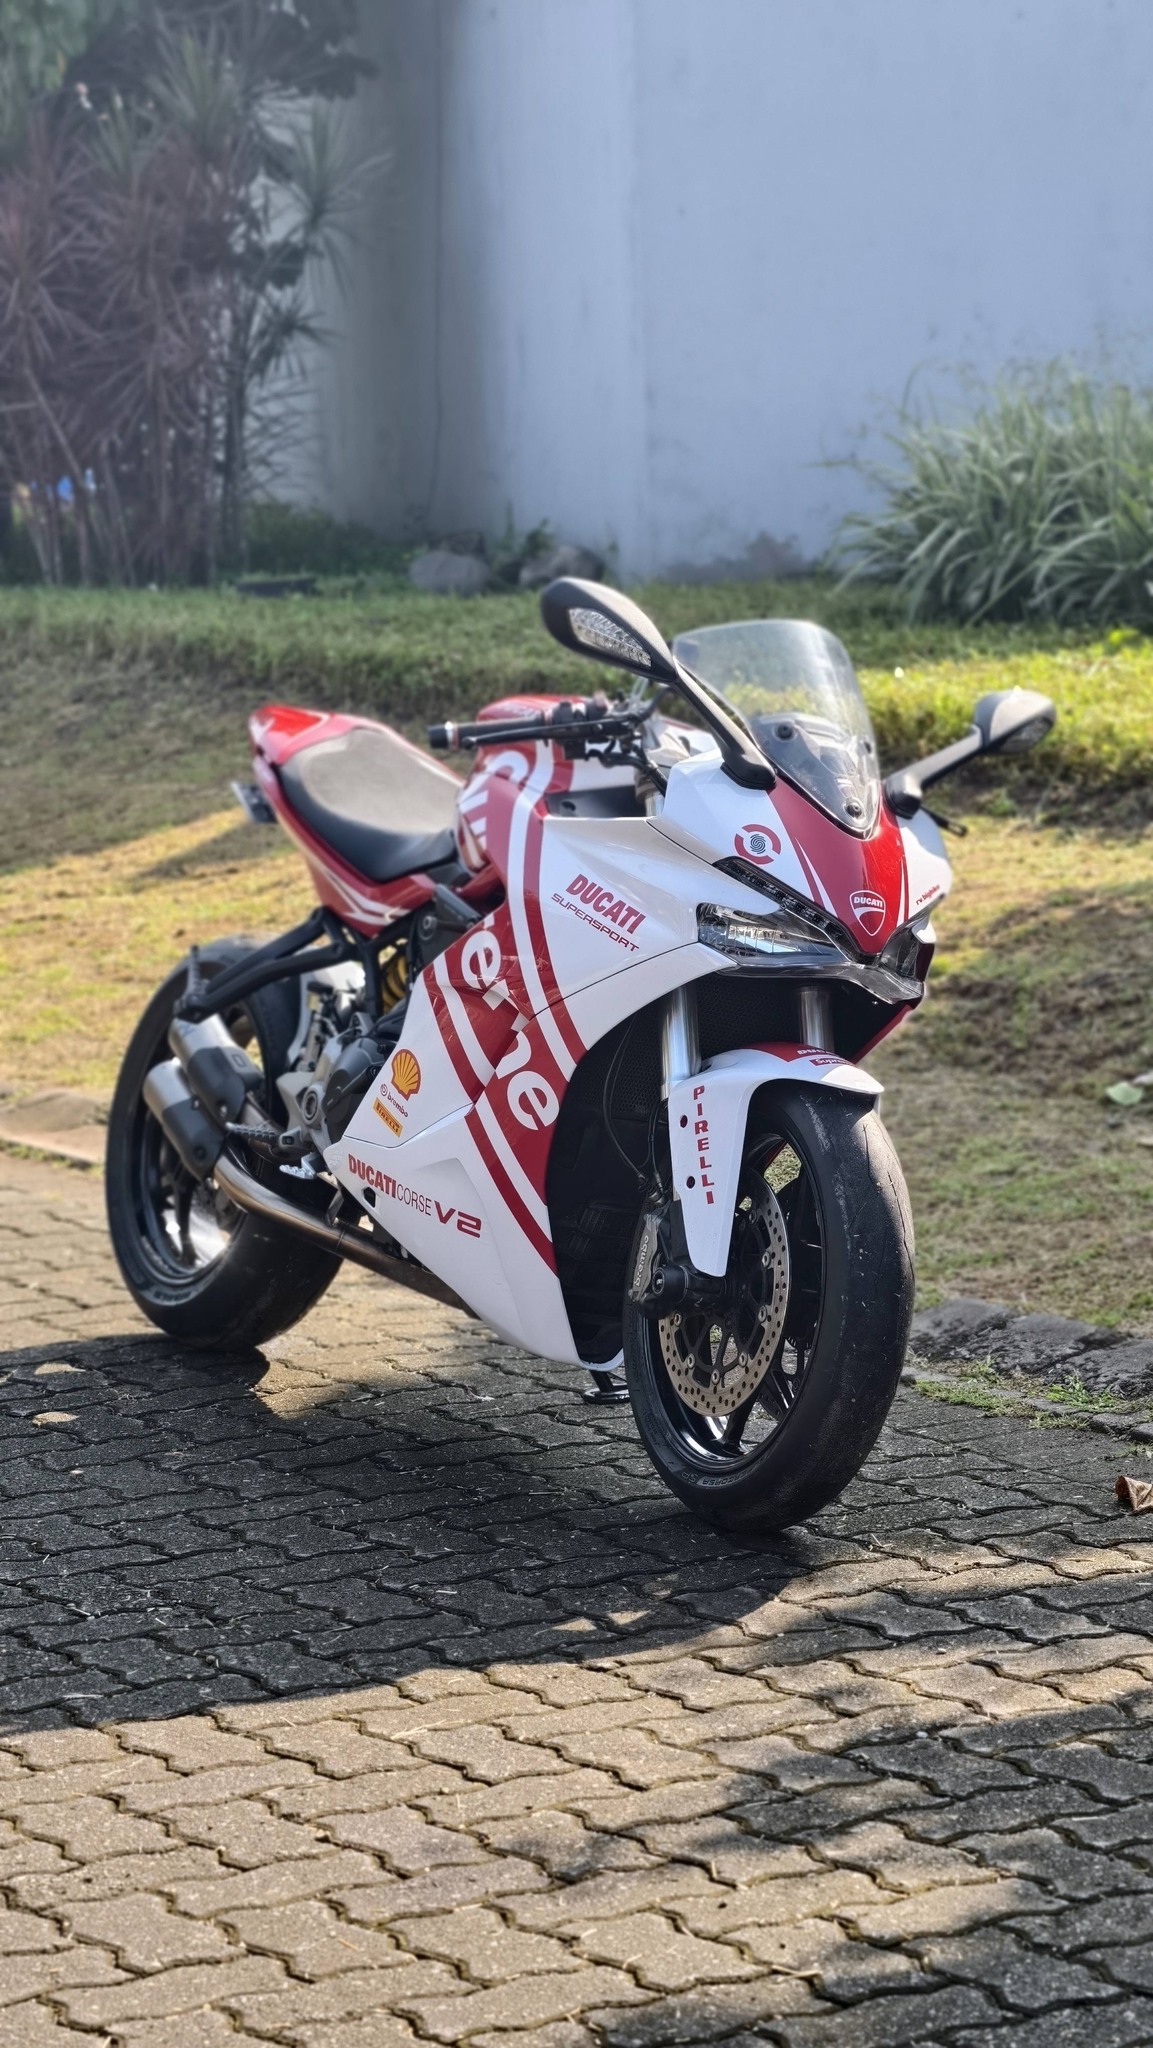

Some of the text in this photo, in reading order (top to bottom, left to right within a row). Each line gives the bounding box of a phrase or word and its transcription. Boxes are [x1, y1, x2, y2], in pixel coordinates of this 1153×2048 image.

[550, 892, 640, 952] SUPERSPORT
[565, 873, 647, 934] DUCATI
[853, 896, 884, 908] DUCATI
[376, 1102, 400, 1133] PIRELLI
[386, 1090, 409, 1118] brembo
[693, 1084, 715, 1205] PIRELLI
[433, 1200, 482, 1239] V2
[633, 1234, 650, 1288] brembo
